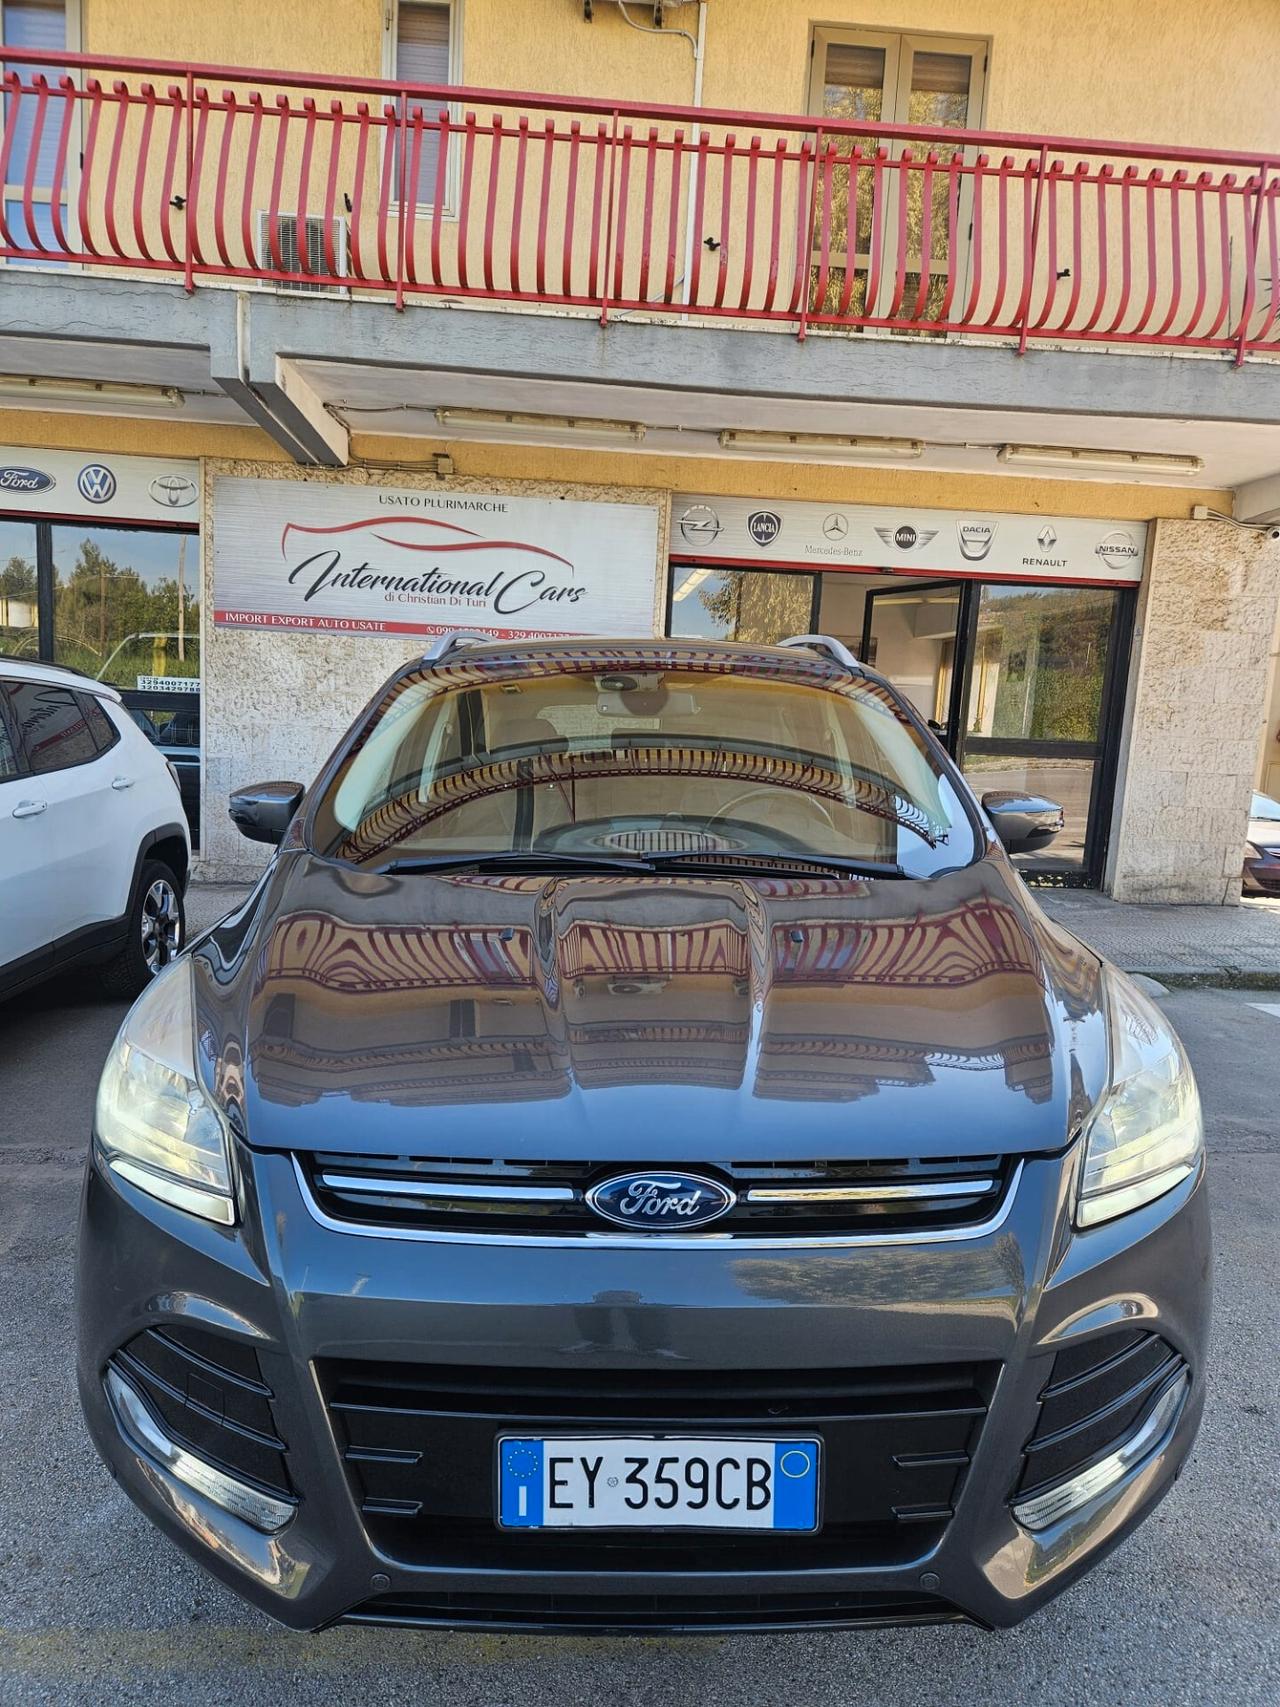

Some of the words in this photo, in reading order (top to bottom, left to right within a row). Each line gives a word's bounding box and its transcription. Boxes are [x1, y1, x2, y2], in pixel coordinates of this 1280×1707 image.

[1, 470, 39, 488] Ford
[379, 494, 420, 506] USATO
[424, 498, 509, 512] PLURIMARCHE
[753, 522, 775, 533] LANCIA
[962, 525, 991, 534] DACIA
[895, 533, 916, 543] MINI
[804, 545, 863, 557] Mercedes-Benz
[1099, 545, 1135, 554] NISSAN
[1022, 557, 1068, 567] RENAULT
[288, 549, 504, 602] International
[493, 570, 589, 615] Cars
[384, 592, 394, 602] di
[398, 593, 446, 605] Christian
[450, 596, 461, 606] Di
[465, 597, 487, 608] Turi
[225, 612, 269, 624] IMPORT
[271, 615, 315, 627] EXPORT
[317, 618, 349, 629] AUTO
[352, 620, 387, 631] USATE
[620, 1180, 701, 1215] Ford
[549, 1457, 604, 1509] EY
[624, 1457, 772, 1510] 359CB
